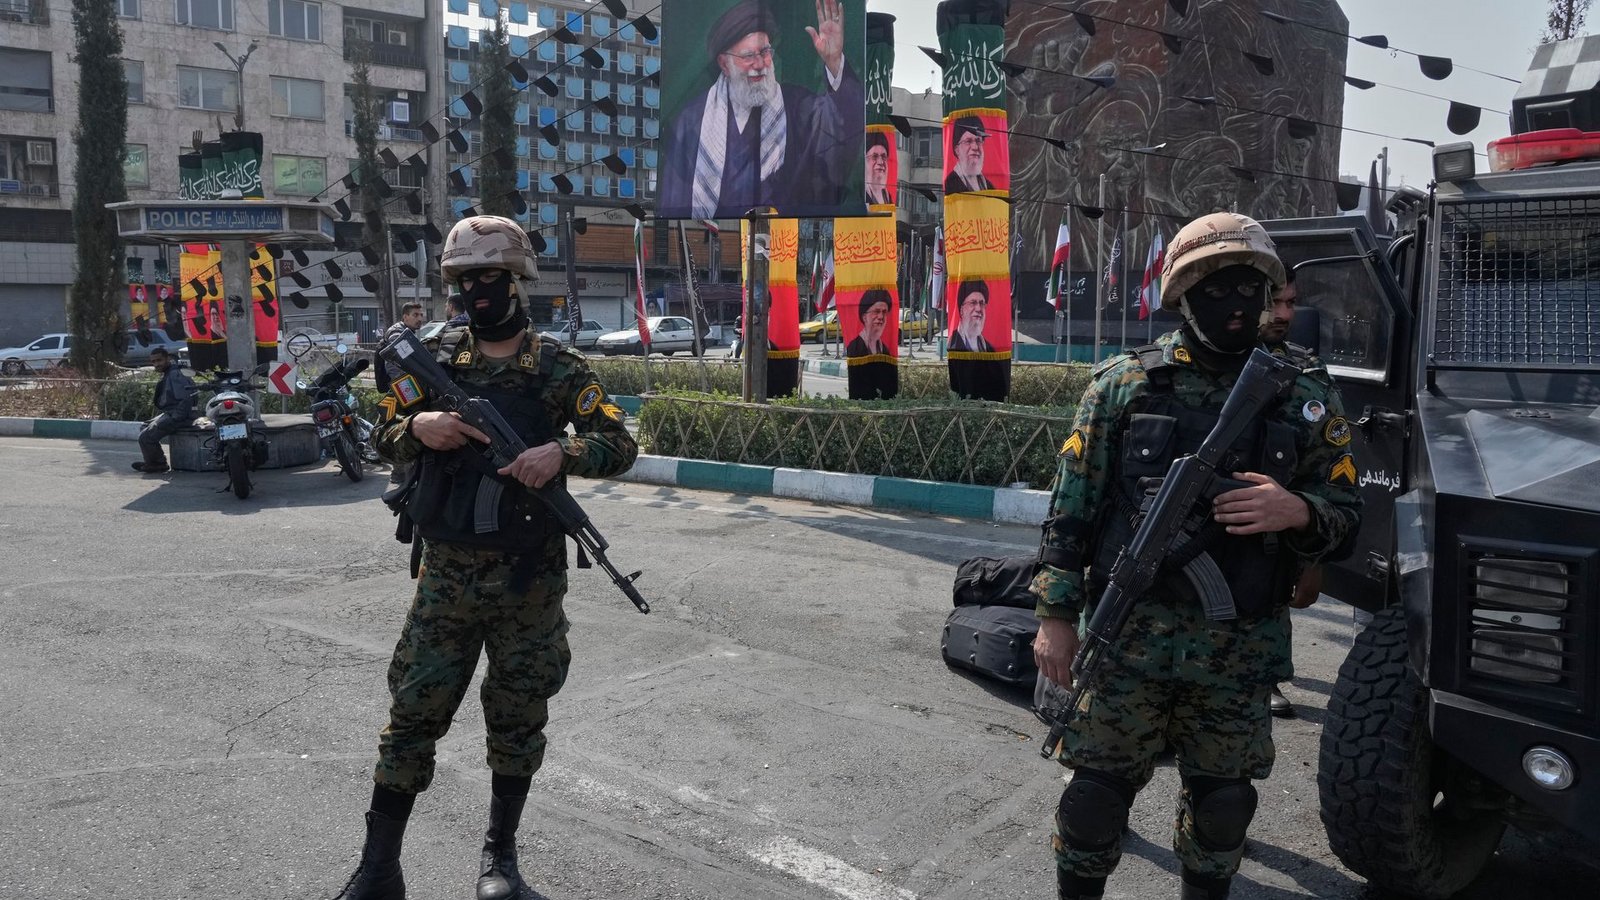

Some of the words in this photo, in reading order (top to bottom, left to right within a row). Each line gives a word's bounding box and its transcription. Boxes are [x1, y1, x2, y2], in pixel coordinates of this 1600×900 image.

[150, 211, 212, 228] POLICE
[228, 211, 250, 228] رانندگی
[251, 214, 255, 228] و
[256, 211, 282, 228] راهنمایی
[1359, 470, 1400, 492] فرماندهی
